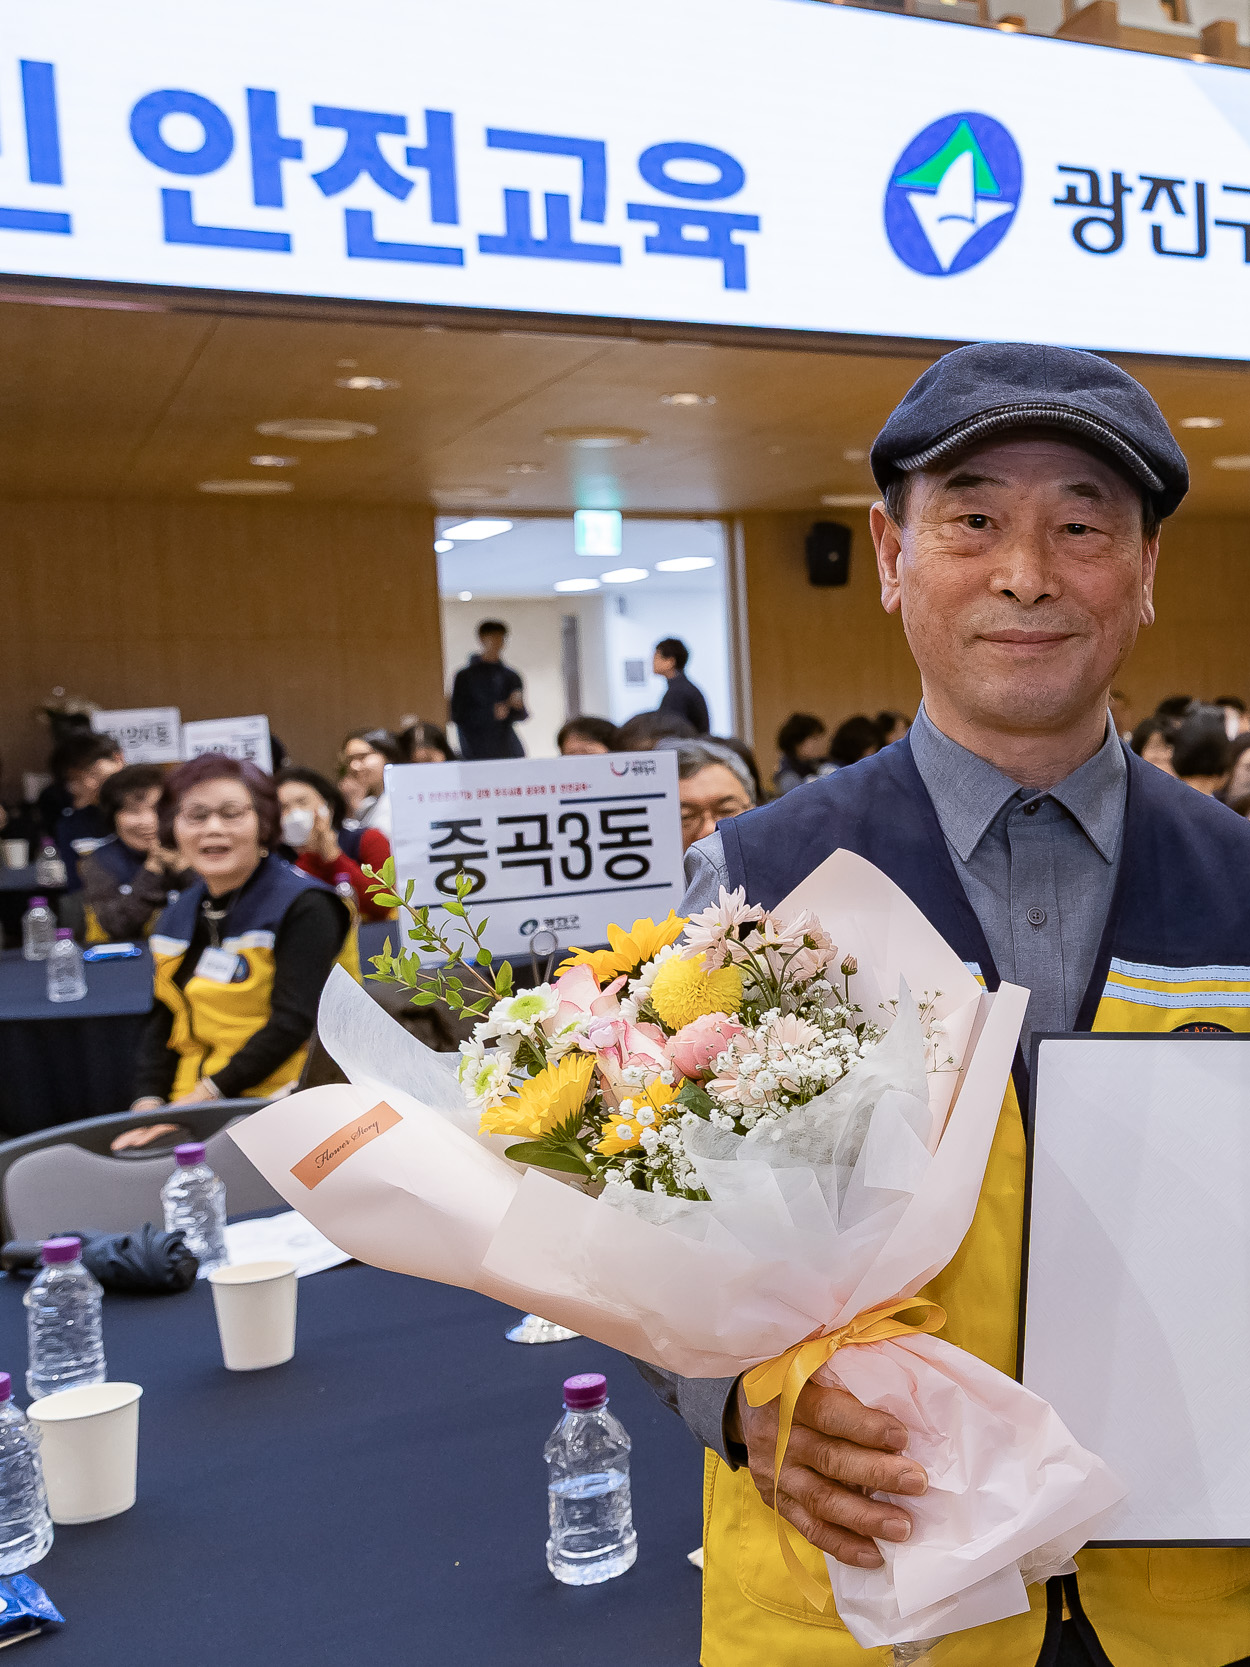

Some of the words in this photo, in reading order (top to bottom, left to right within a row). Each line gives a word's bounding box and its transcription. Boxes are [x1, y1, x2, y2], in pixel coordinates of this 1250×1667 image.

[129, 87, 761, 292] 안전교육
[429, 807, 653, 896] 중곡3동
[315, 1139, 350, 1169] Flower
[351, 1121, 380, 1142] Story
